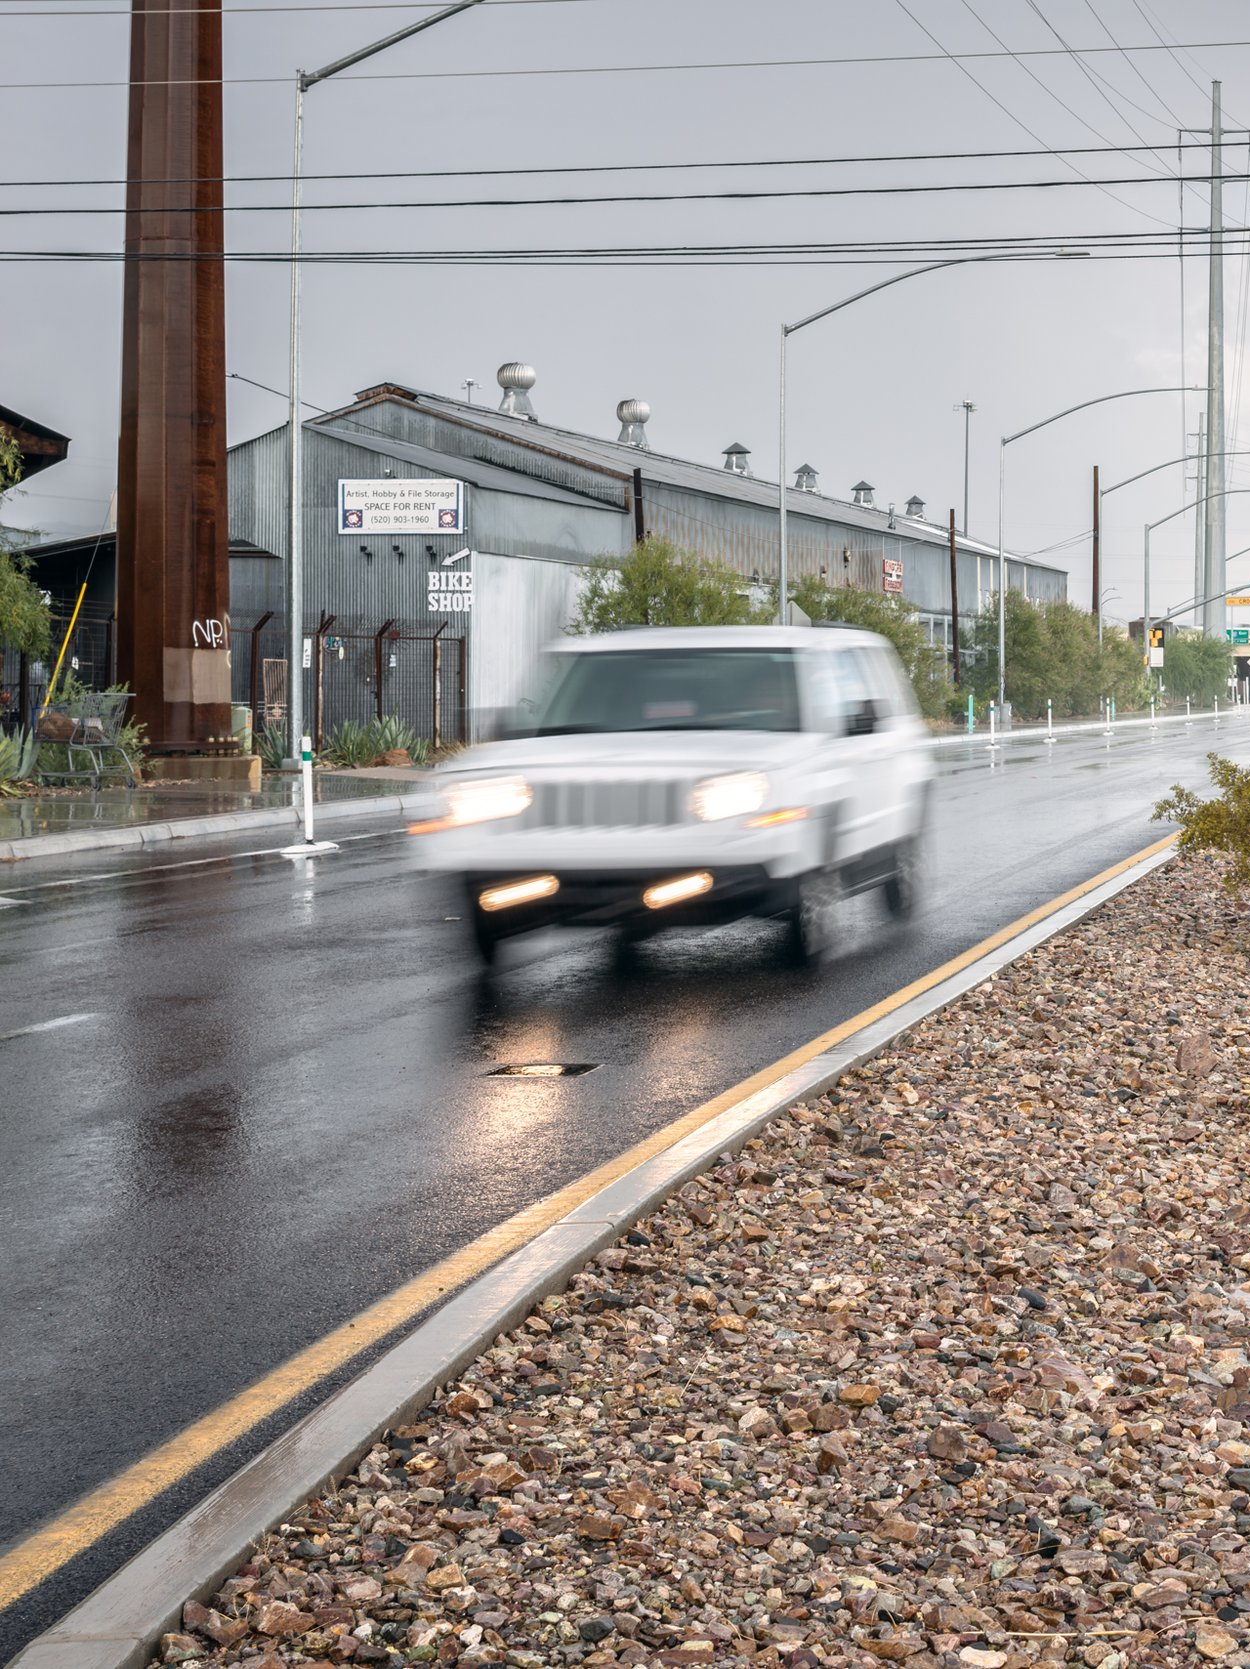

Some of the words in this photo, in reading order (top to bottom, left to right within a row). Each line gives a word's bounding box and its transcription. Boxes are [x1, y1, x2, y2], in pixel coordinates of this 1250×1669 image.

[346, 490, 370, 498] Artist,
[372, 490, 397, 499] Hobby
[408, 490, 422, 498] File
[424, 490, 455, 499] Storage
[364, 502, 390, 511] SPACE
[393, 502, 411, 511] FOR
[413, 502, 437, 511] RENT
[370, 515, 391, 524] (520)
[393, 515, 430, 524] 903-1960
[428, 571, 472, 591] BIKE
[428, 592, 475, 612] SHOP
